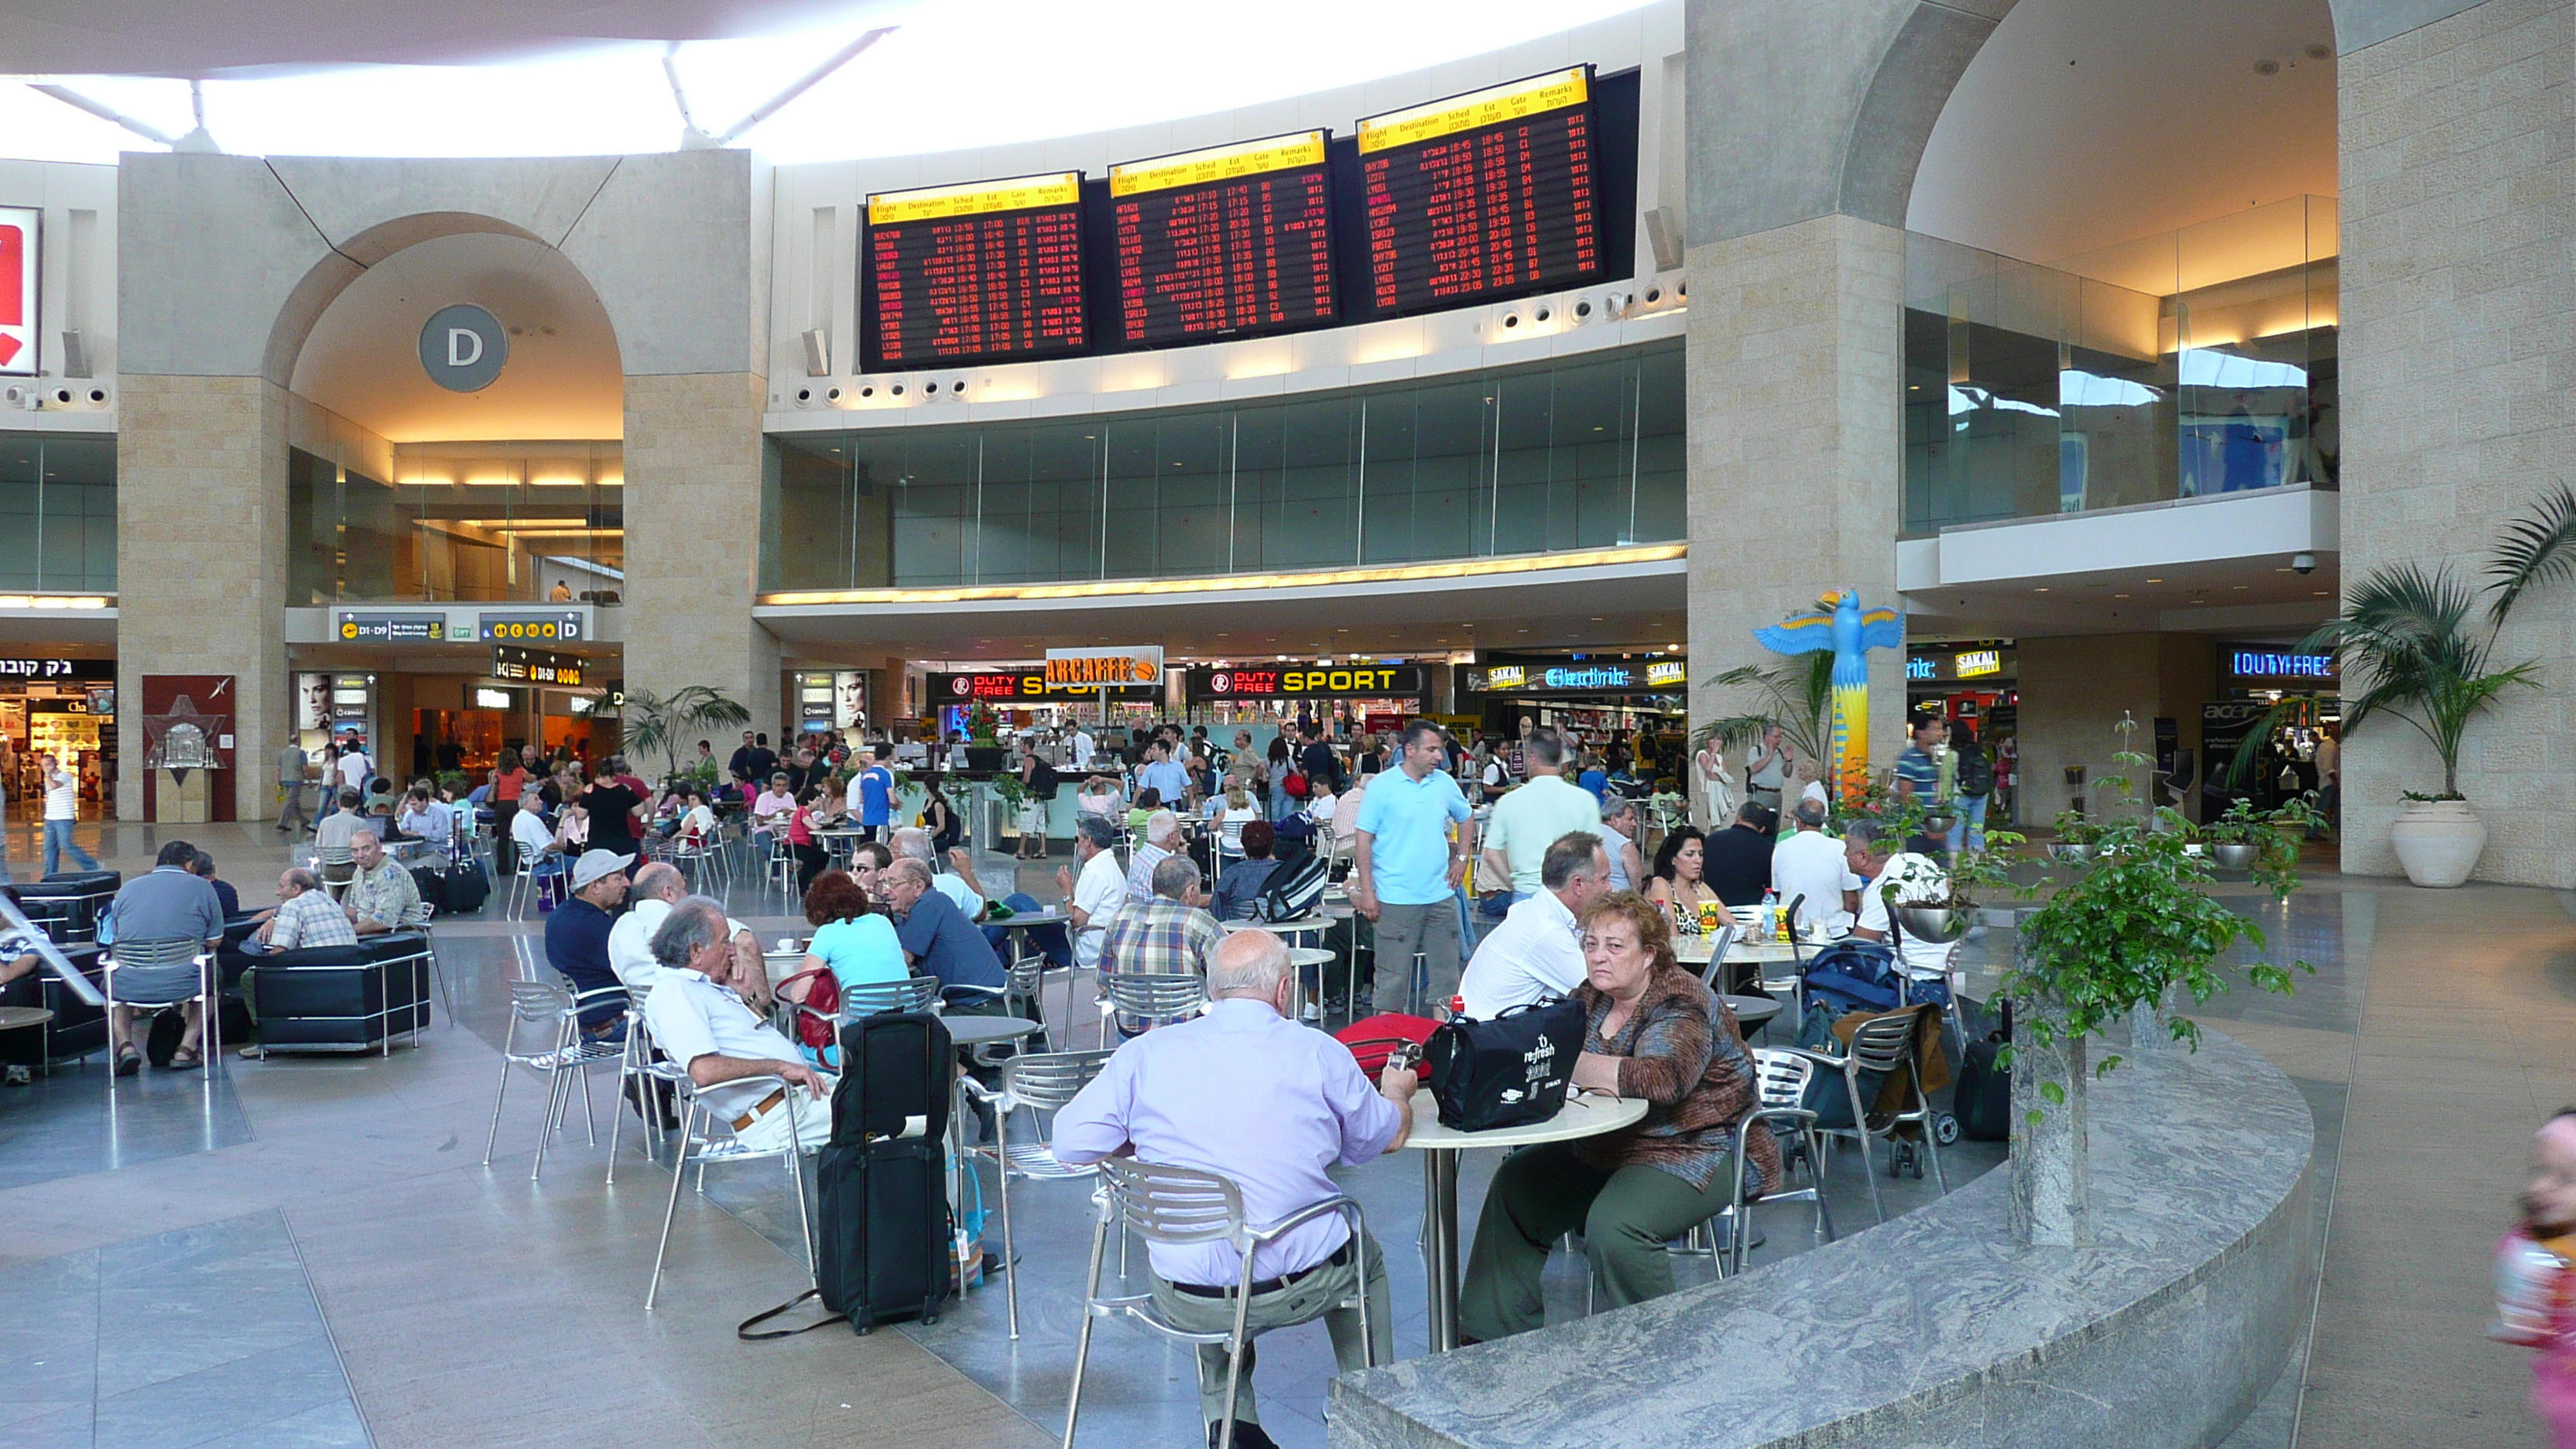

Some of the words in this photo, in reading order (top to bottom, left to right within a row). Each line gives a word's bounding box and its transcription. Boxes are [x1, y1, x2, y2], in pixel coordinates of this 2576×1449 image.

[1367, 129, 1387, 141] Flight
[1399, 117, 1439, 132] Destination
[1448, 109, 1470, 121] Sched
[1485, 103, 1495, 112] Est
[1511, 96, 1527, 105] Gate
[1540, 84, 1572, 99] Remarks
[1415, 130, 1426, 139] יעד
[1513, 106, 1526, 115] שער
[1547, 96, 1567, 108] הערות
[1451, 139, 1471, 153] 18:45
[1483, 132, 1504, 145] 18:45
[1519, 127, 1528, 137] C2
[1451, 151, 1472, 164] 18:50
[1484, 144, 1505, 157] 18:50
[1520, 139, 1529, 149] C1
[1118, 176, 1138, 185] Flight
[1149, 167, 1187, 180] Destination
[1195, 161, 1215, 171] Sched
[1281, 146, 1311, 156] Remarks
[1255, 162, 1269, 170] שער
[1287, 155, 1307, 165] הערות
[1452, 163, 1473, 176] 18:55
[1485, 156, 1506, 169] 18:55
[1454, 173, 1475, 187] 18:55
[1485, 167, 1506, 181] 18:55
[1197, 190, 1217, 201] 17:10
[1454, 186, 1475, 199] 19:30
[1486, 180, 1507, 193] 19:30
[877, 205, 896, 214] Flight
[908, 200, 945, 210] Destination
[954, 196, 973, 204] Sched
[1038, 186, 1067, 195] Remarks
[1044, 195, 1063, 204] הערות
[1198, 200, 1218, 212] 17:15
[1228, 196, 1249, 207] 17:15
[1455, 197, 1476, 211] 19:35
[1488, 191, 1509, 204] 19:35
[1200, 211, 1219, 223] 17:20
[1229, 207, 1249, 218] 17:20
[1456, 209, 1477, 223] 19:45
[1488, 204, 1509, 216] 19:45
[1200, 221, 1220, 233] 17:20
[1230, 218, 1250, 229] 20:30
[1457, 221, 1478, 235] 19:50
[1489, 215, 1511, 228] 19:50
[1201, 233, 1221, 244] 17:30
[1458, 233, 1479, 247] 20:00
[1489, 227, 1511, 241] 20:00
[1201, 243, 1221, 255] 17:35
[1458, 245, 1480, 259] 20:40
[1490, 238, 1512, 252] 20:40
[1459, 256, 1481, 270] 21:45
[1492, 250, 1513, 264] 21:45
[1203, 265, 1223, 276] 18:00
[1233, 262, 1253, 272] 18:00
[1460, 268, 1482, 282] 22:30
[1492, 262, 1514, 276] 22:30
[1204, 276, 1224, 288] 18:00
[1234, 272, 1254, 283] 18:00
[1461, 279, 1483, 293] 23:05
[1493, 274, 1515, 286] 23:05
[1204, 286, 1225, 297] 18:00
[1235, 283, 1254, 293] 18:00
[1205, 297, 1225, 309] 18:25
[1206, 308, 1226, 319] 18:30
[1236, 304, 1256, 315] 18:30
[1207, 319, 1227, 330] 18:40
[449, 328, 483, 366] D
[565, 623, 577, 637] D
[46, 659, 72, 677] ג'ק
[1958, 651, 1996, 669] SAKAL
[2242, 653, 2284, 674] DUTY
[1234, 672, 1276, 682] DUTY
[1490, 666, 1522, 681] SAKAL
[1649, 663, 1682, 678] SAKAL
[974, 676, 1016, 686] DUTY
[1234, 683, 1275, 692] FREE
[1283, 670, 1396, 690] SPORT
[974, 686, 1014, 695] FREE
[2204, 704, 2256, 719] acer
[1537, 1033, 1548, 1047] to
